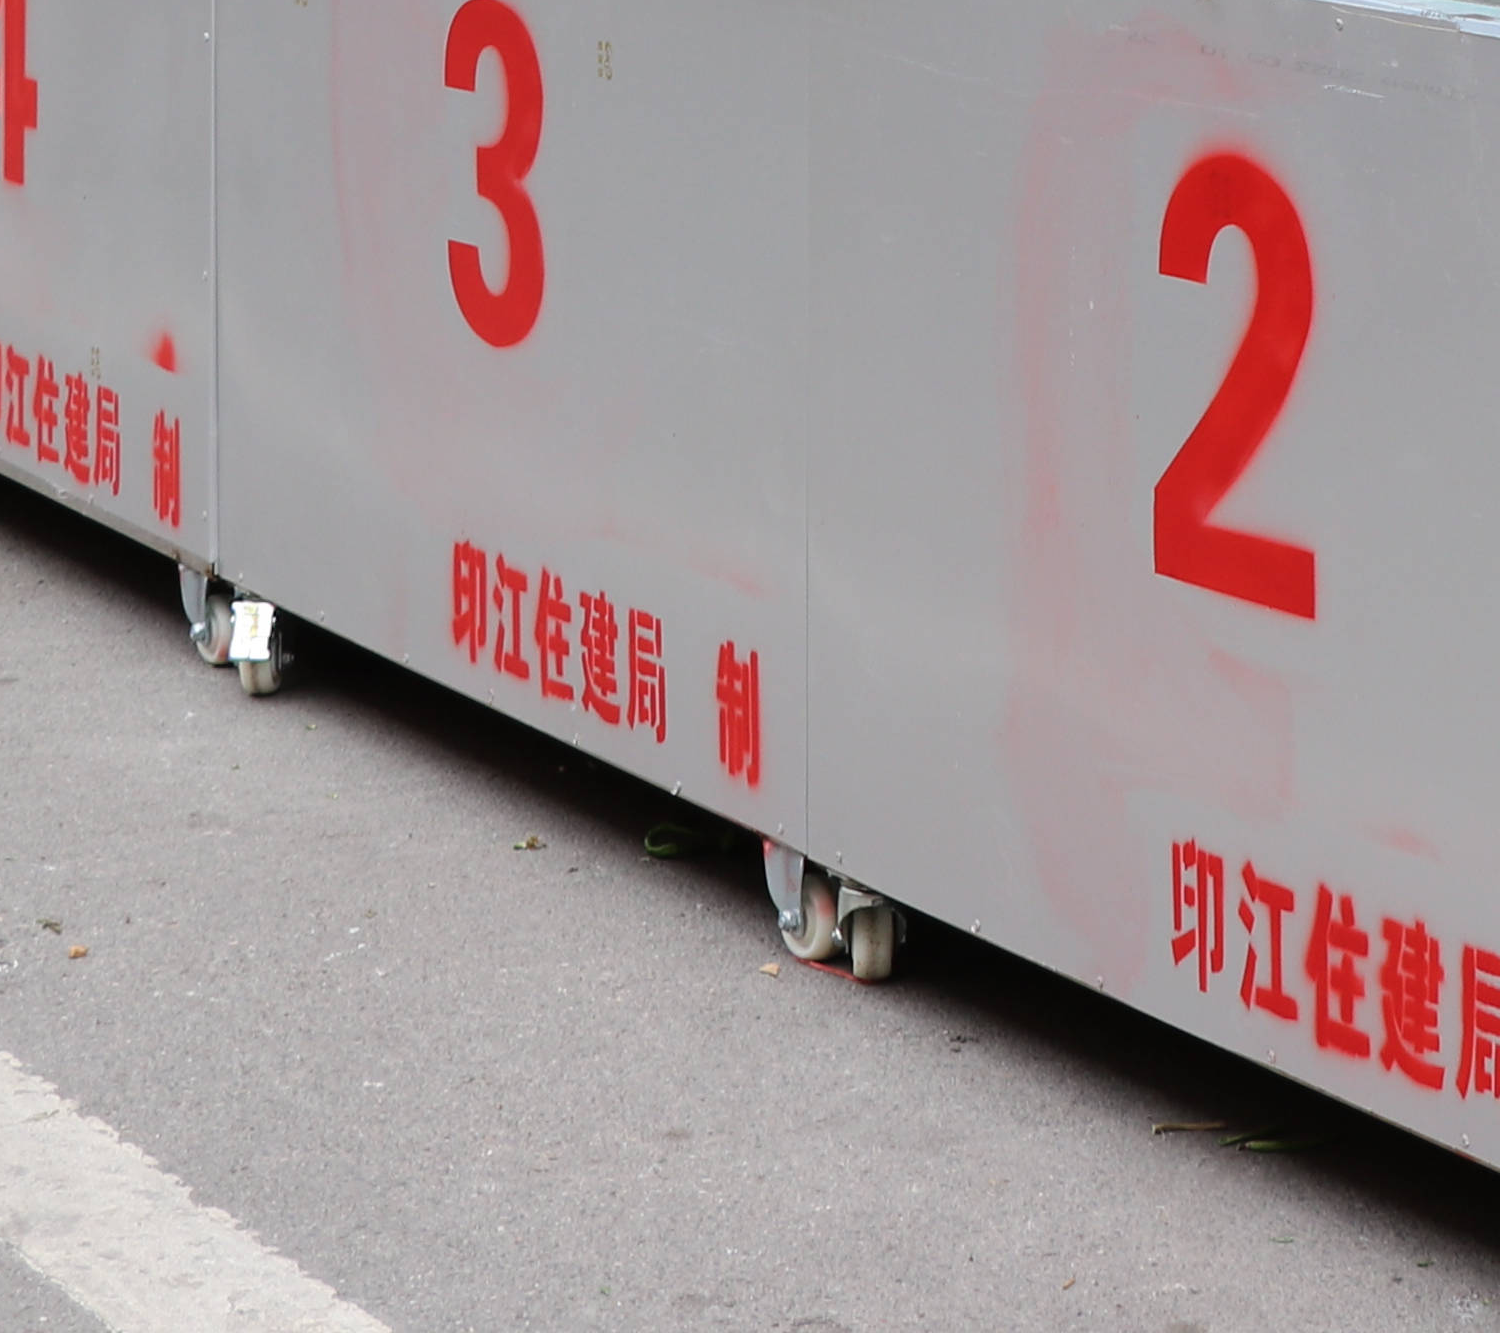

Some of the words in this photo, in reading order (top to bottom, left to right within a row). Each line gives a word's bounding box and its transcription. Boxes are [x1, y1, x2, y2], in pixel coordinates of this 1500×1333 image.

[152, 410, 181, 530] 制
[1154, 151, 1316, 620] 2
[453, 540, 669, 745] 印江住建局
[716, 640, 761, 788] 制
